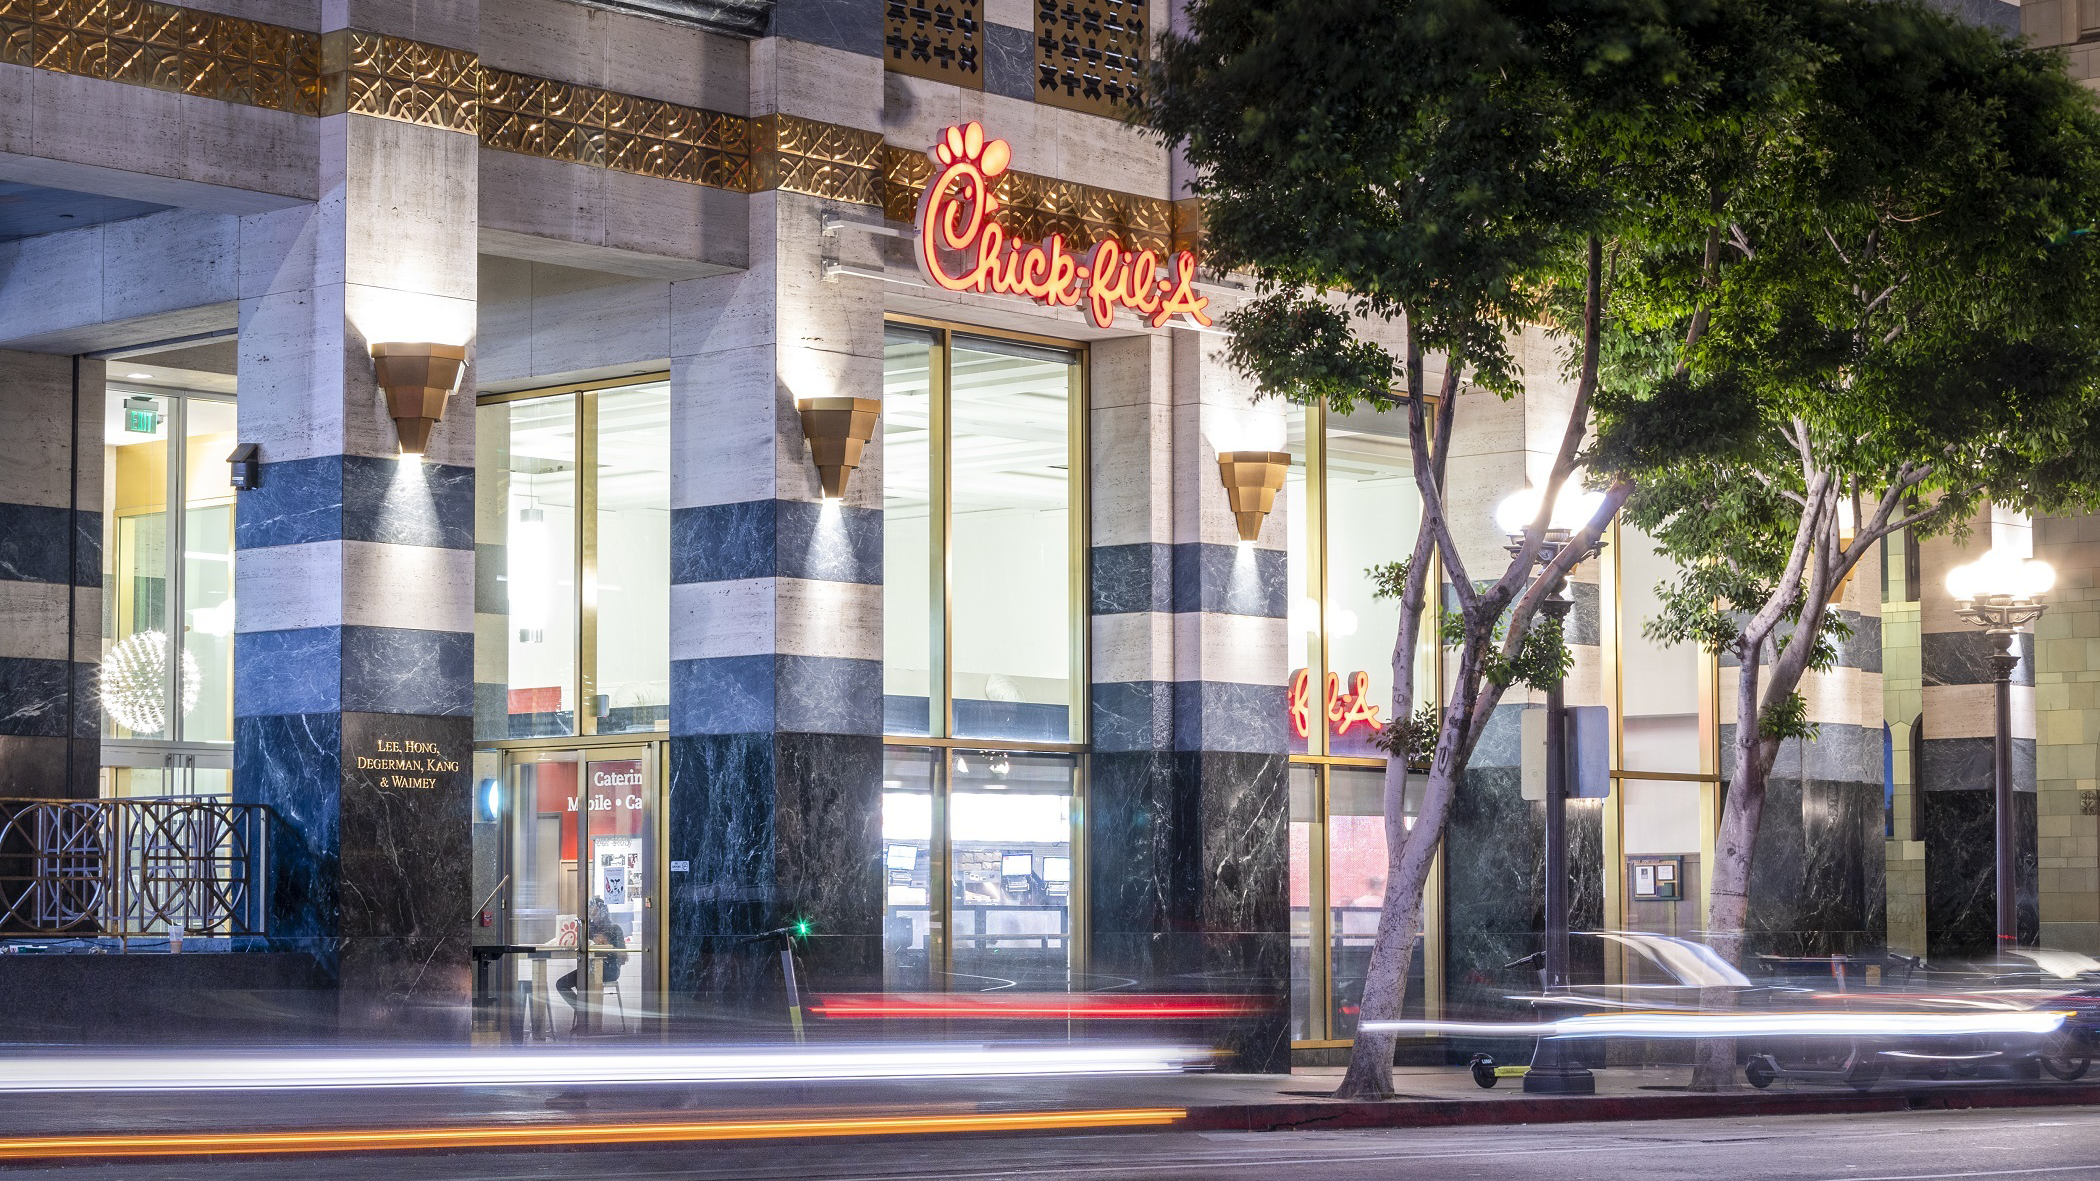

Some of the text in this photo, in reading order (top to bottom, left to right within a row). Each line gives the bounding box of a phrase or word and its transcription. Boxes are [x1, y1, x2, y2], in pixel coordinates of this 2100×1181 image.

[922, 160, 1213, 328] Chick-fil-A
[131, 411, 153, 432] EXIT
[377, 739, 440, 756] LEE, HONG,
[357, 756, 459, 773] DEGERMAN, KANG
[380, 775, 436, 789] & WAIMEY
[594, 768, 643, 786] Caterin
[625, 794, 643, 810] Ca
